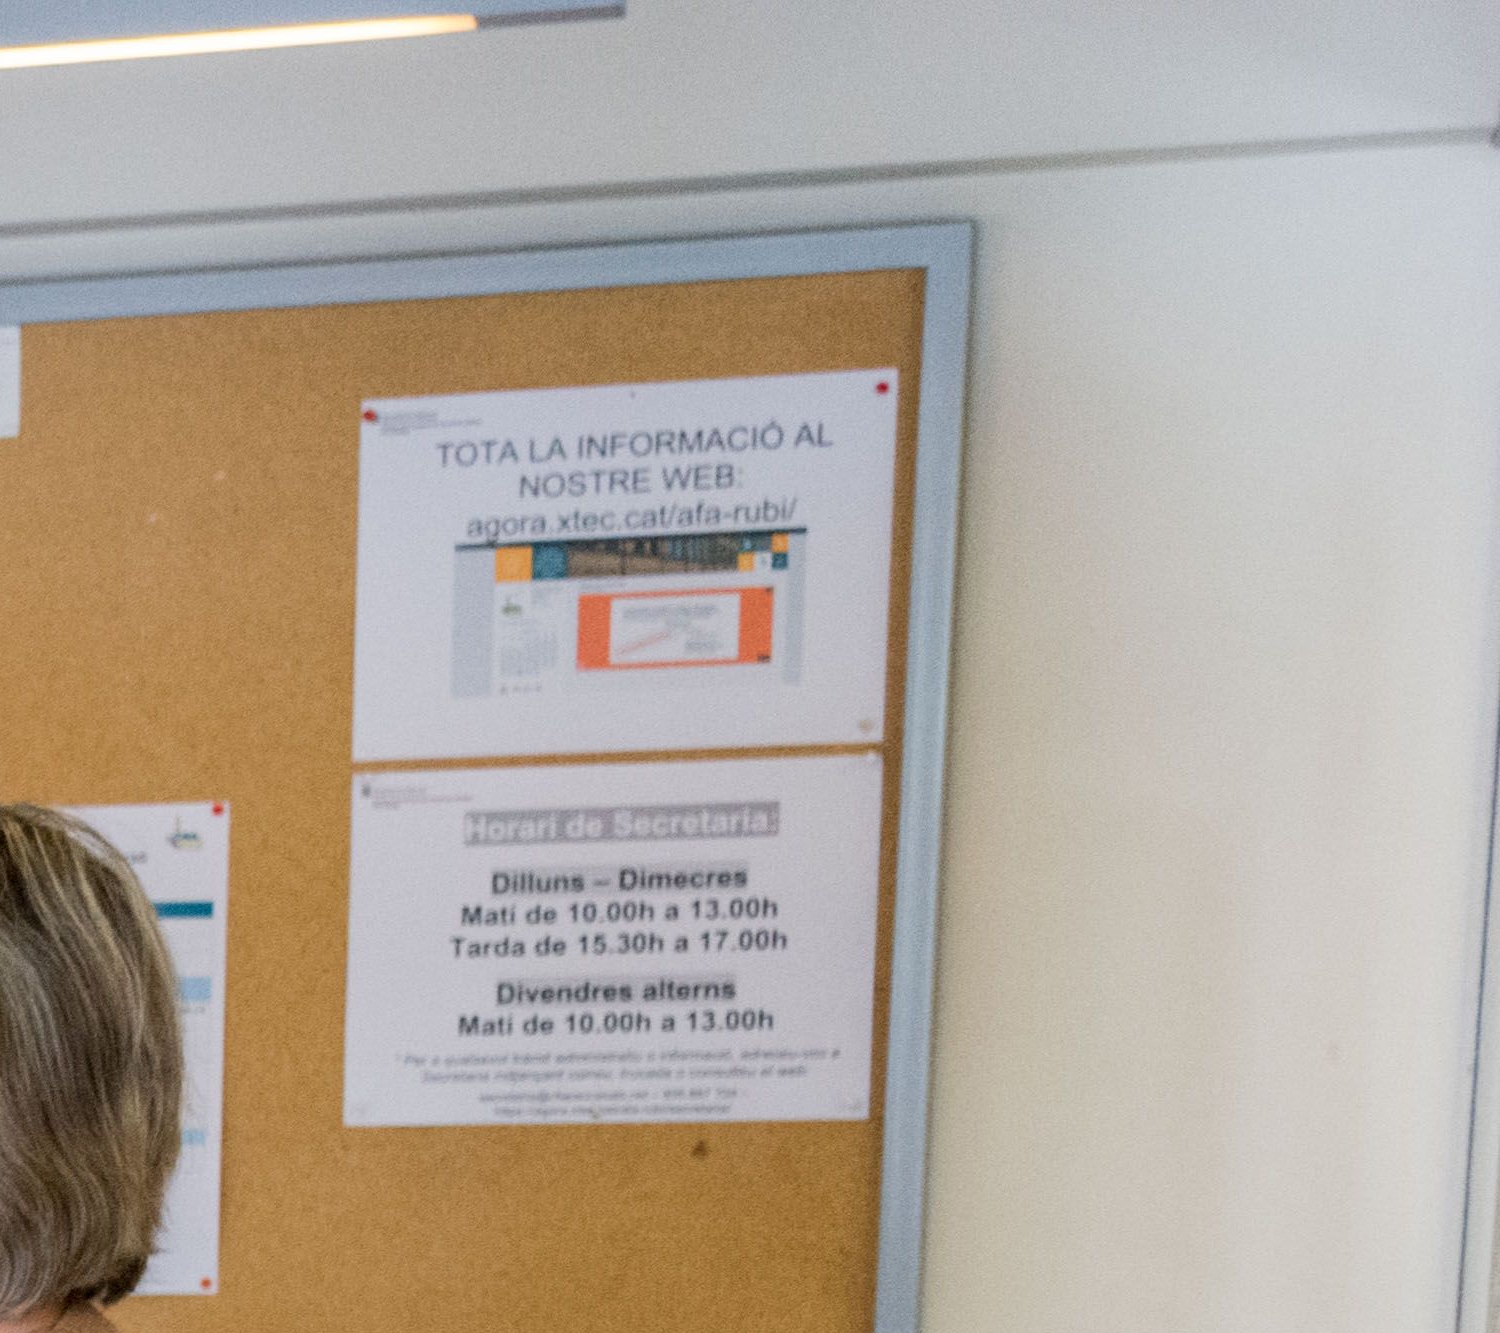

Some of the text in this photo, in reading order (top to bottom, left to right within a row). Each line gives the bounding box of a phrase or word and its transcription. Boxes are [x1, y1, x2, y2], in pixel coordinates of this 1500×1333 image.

[438, 421, 834, 468] TOTA LA INFORMACIÓ AL
[519, 465, 745, 499] NOSTRE WEB:
[466, 812, 562, 846] Horari
[491, 871, 584, 896] Dilluns
[619, 867, 748, 891] Dimecres
[526, 901, 557, 925] de
[569, 899, 655, 924] 10.00h
[664, 906, 680, 921] a
[691, 898, 779, 919] 13.00h
[452, 929, 788, 959] Tarda de 15.30h a 17.00h
[496, 978, 737, 1006] Divendres alterns
[523, 1012, 553, 1035] de
[565, 1011, 652, 1034] 10.00h
[660, 1017, 676, 1031] a
[687, 1009, 774, 1032] 13.00h
